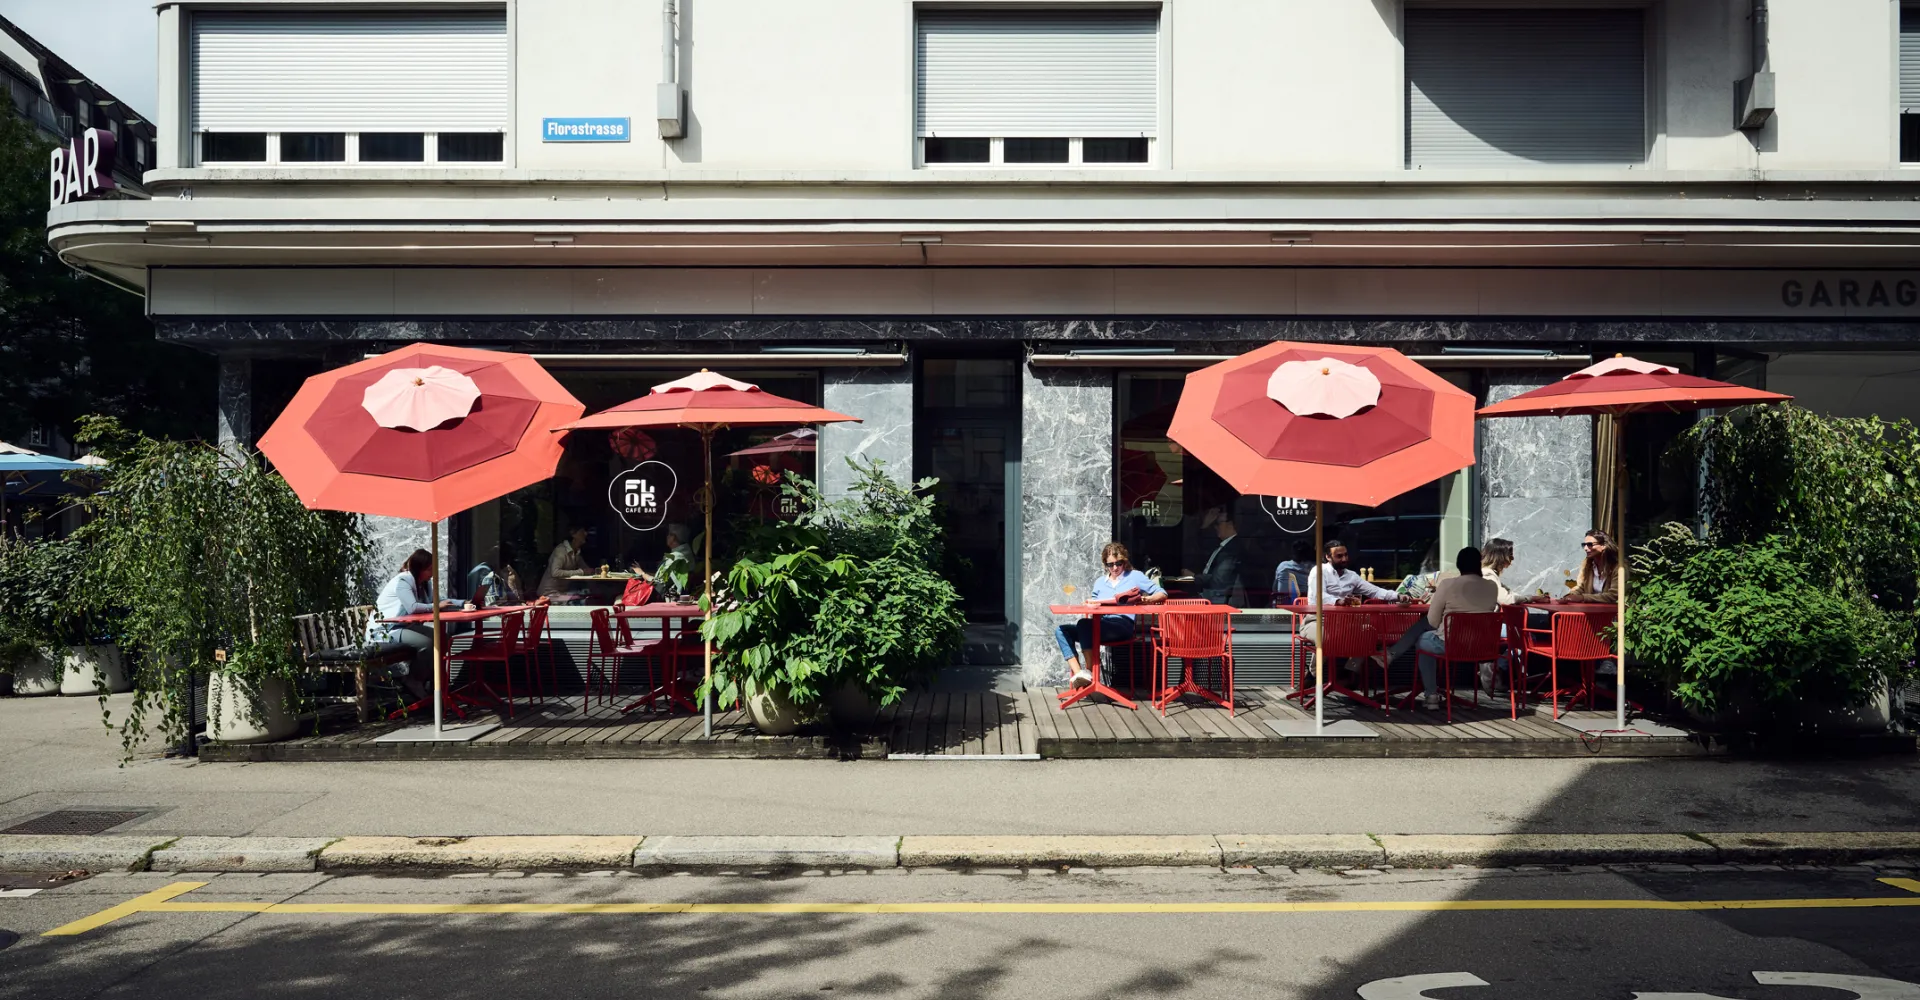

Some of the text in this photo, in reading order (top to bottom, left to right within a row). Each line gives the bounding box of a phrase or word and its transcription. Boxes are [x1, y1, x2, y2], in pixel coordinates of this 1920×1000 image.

[547, 122, 624, 135] Florastrasse
[50, 127, 99, 210] BAR
[1781, 279, 1918, 308] GARAG
